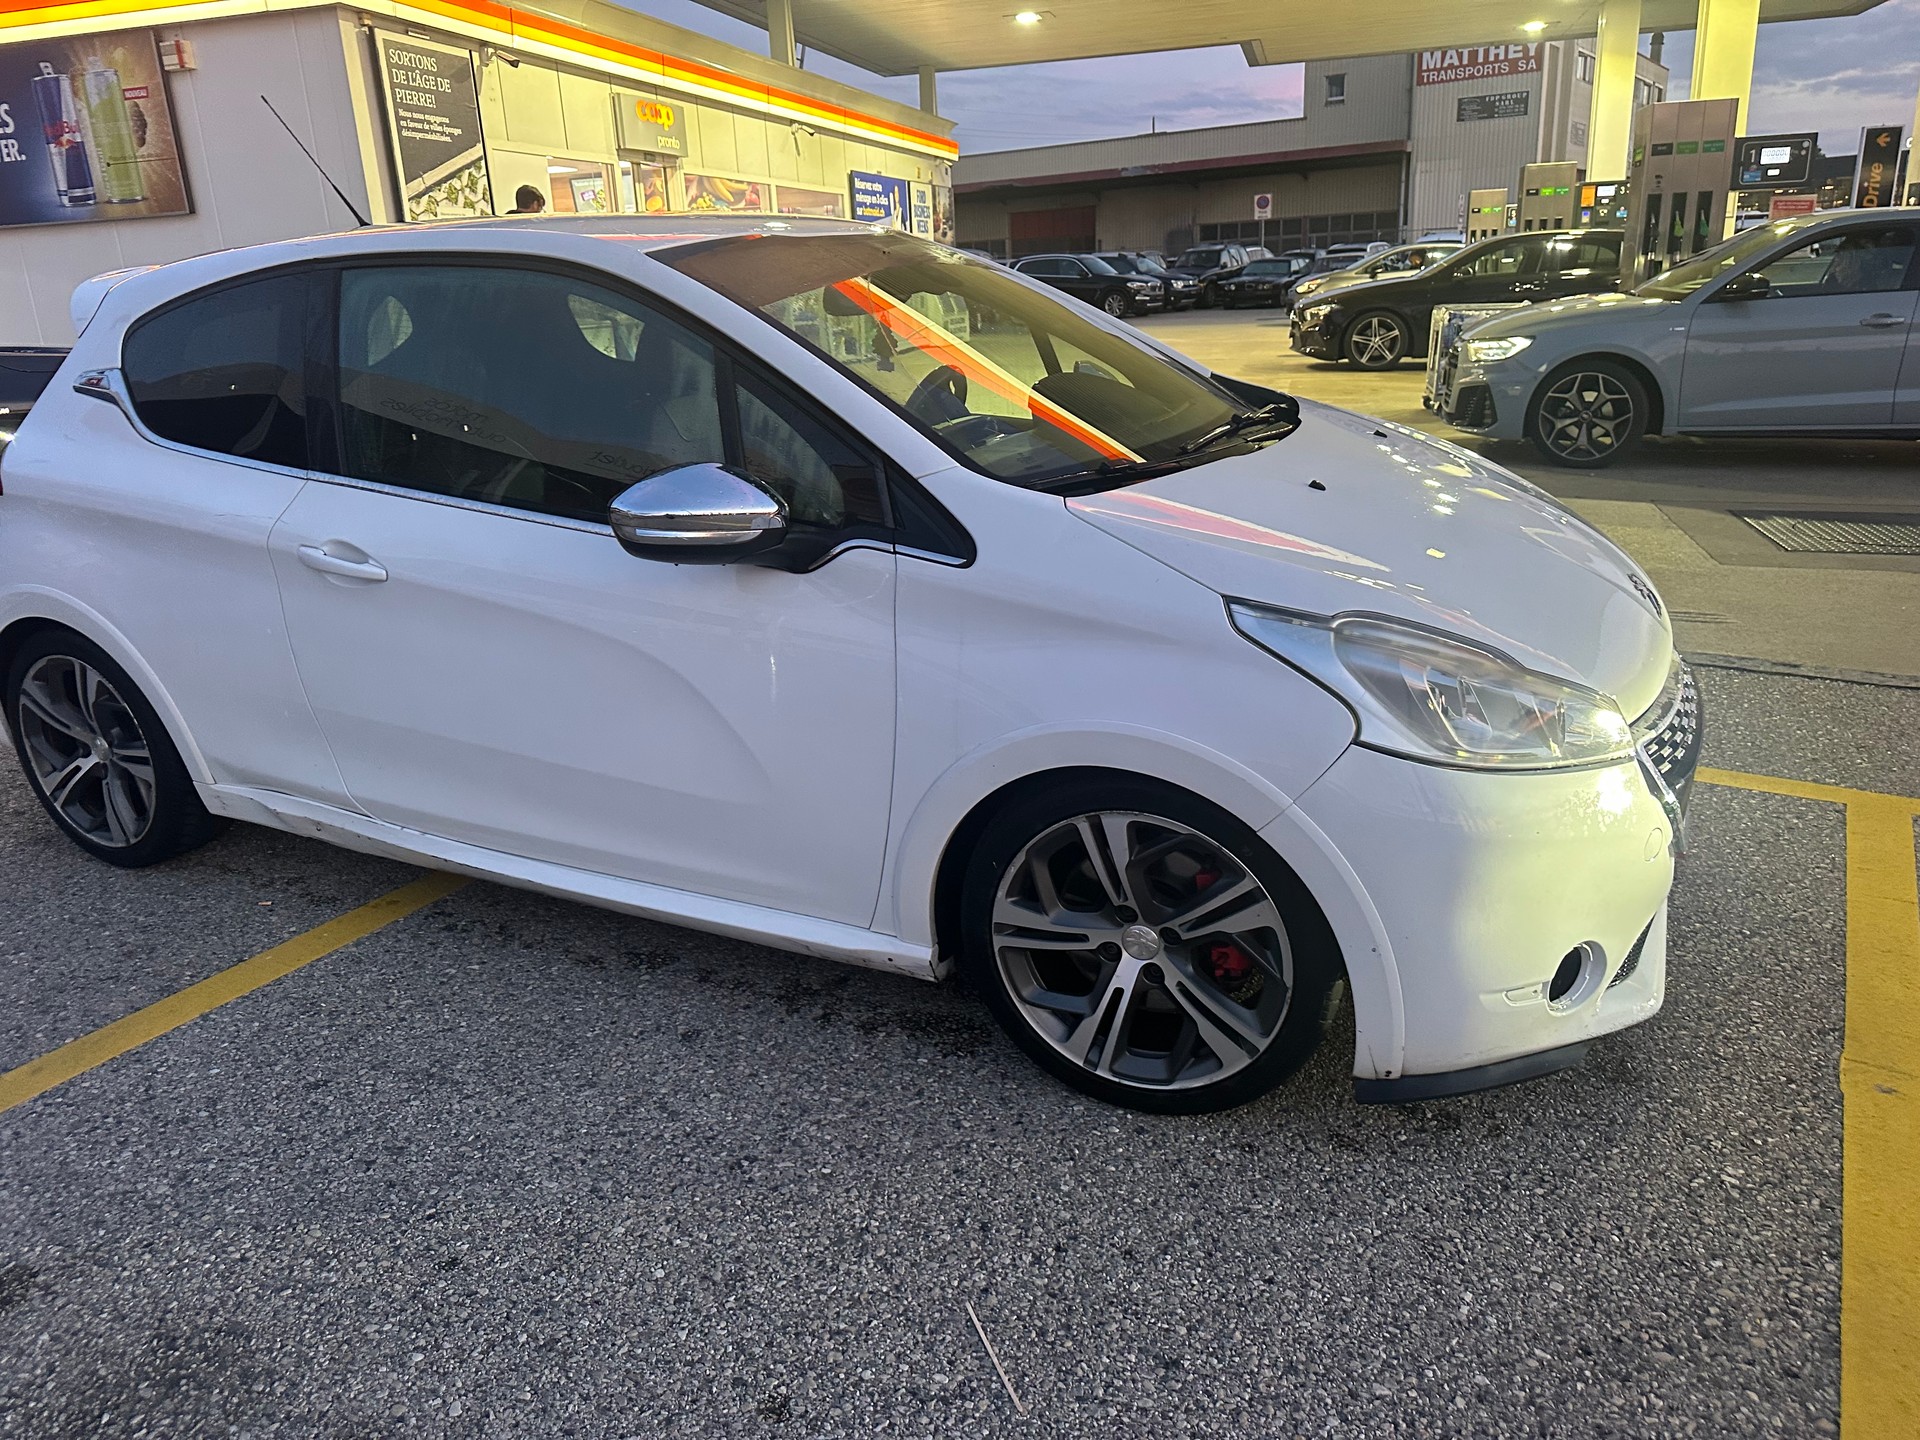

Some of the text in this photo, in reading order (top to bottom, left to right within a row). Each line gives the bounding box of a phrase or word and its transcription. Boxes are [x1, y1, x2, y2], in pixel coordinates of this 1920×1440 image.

[389, 48, 438, 72] SORTONS
[1421, 42, 1540, 70] MATTHEY
[392, 68, 407, 85] DE
[437, 77, 452, 93] DE
[1421, 59, 1537, 83] TRANSPORTS SA
[395, 88, 437, 109] PIERRE!
[398, 108, 412, 118] Nous
[412, 112, 425, 120] nous
[636, 99, 675, 132] coop
[423, 121, 430, 130] de
[657, 135, 681, 149] pronto
[1750, 149, 1756, 163] 1
[1619, 186, 1626, 195] 3
[1862, 162, 1884, 207] Drive
